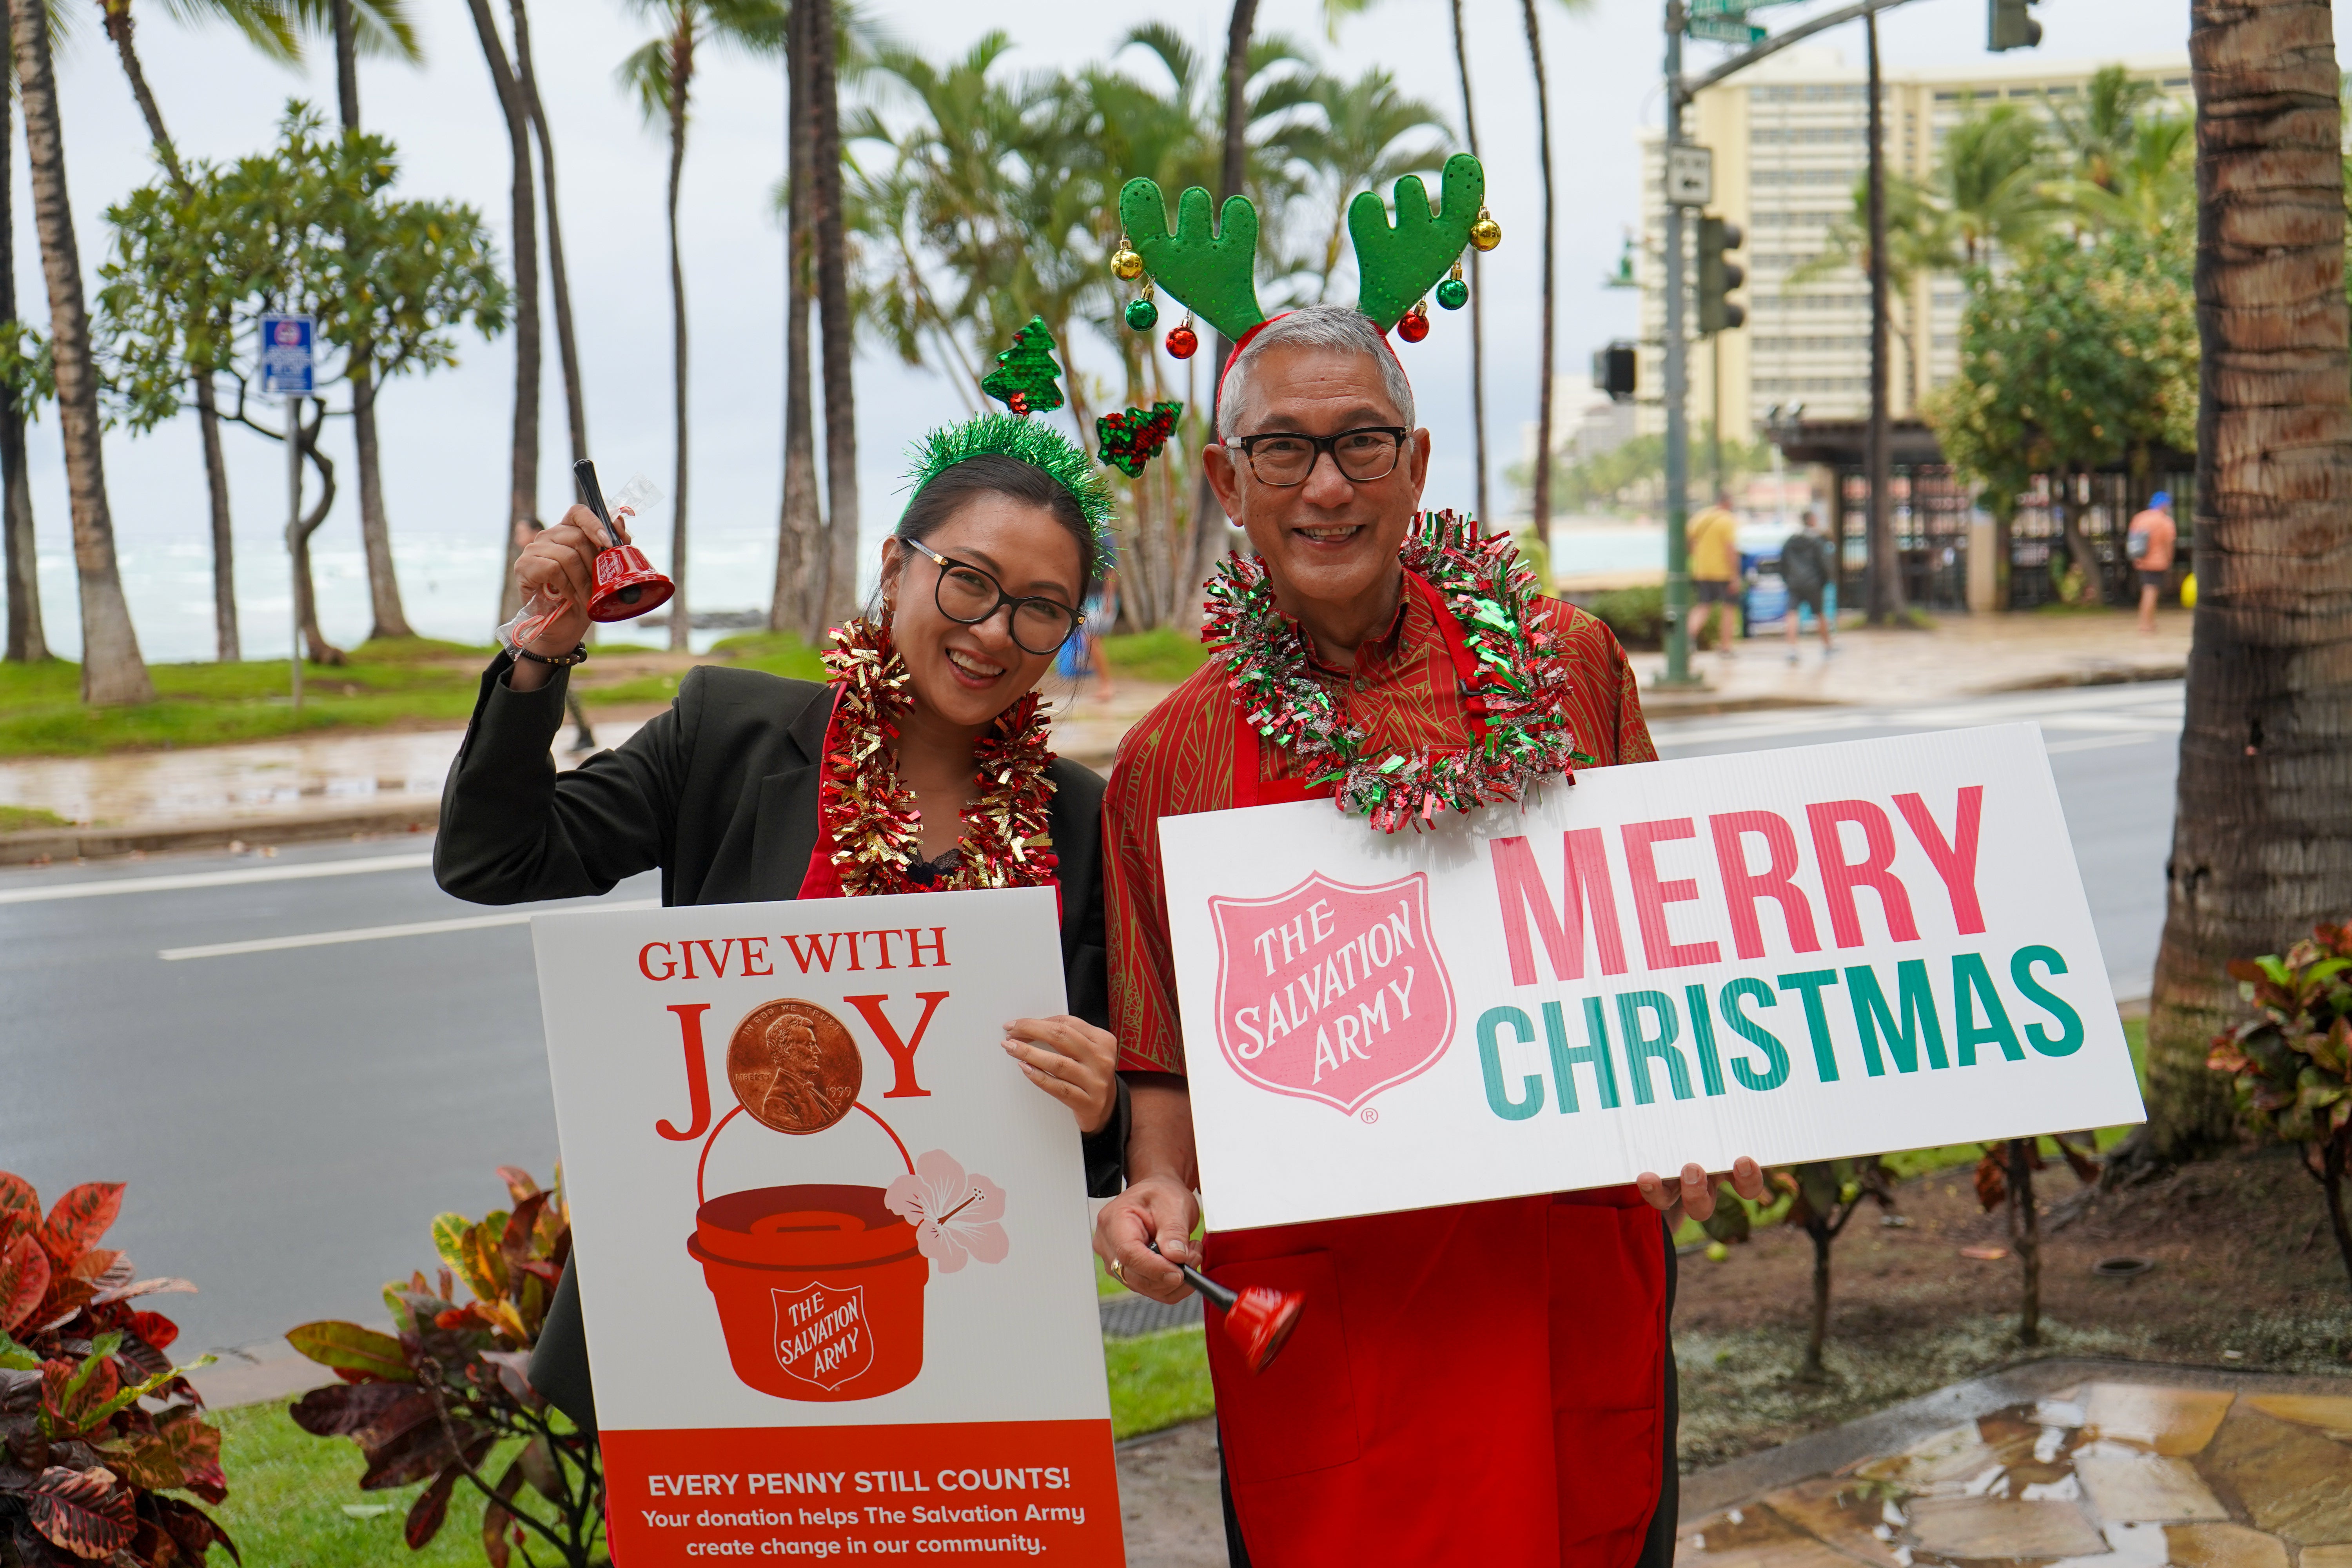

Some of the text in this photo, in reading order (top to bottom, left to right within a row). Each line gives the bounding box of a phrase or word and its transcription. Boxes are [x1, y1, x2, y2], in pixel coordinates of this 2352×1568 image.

[600, 559, 609, 572] THE
[600, 557, 618, 583] SALVATION
[607, 564, 619, 579] ARMY
[1490, 786, 1986, 986] MERRY
[1255, 898, 1334, 977] THE
[639, 927, 951, 981] GIVE WITH
[1235, 900, 1416, 1059] SALVATION
[742, 1024, 754, 1035] IN
[753, 1009, 775, 1024] GOD
[806, 1007, 842, 1032] TRUST
[1312, 966, 1414, 1085] ARMY
[1477, 946, 2083, 1120] CHRISTMAS
[735, 1073, 771, 1081] LIBERTY
[826, 1086, 852, 1098] 1999
[789, 1292, 824, 1327] THE
[780, 1296, 859, 1365] SALVATION
[814, 1327, 858, 1379] ARMY
[648, 1467, 1071, 1496] EVERY PENNY STILL COUNTS!
[642, 1504, 1085, 1529] Your donation helps The Salvation Army
[687, 1534, 1047, 1559] create change in our community.
